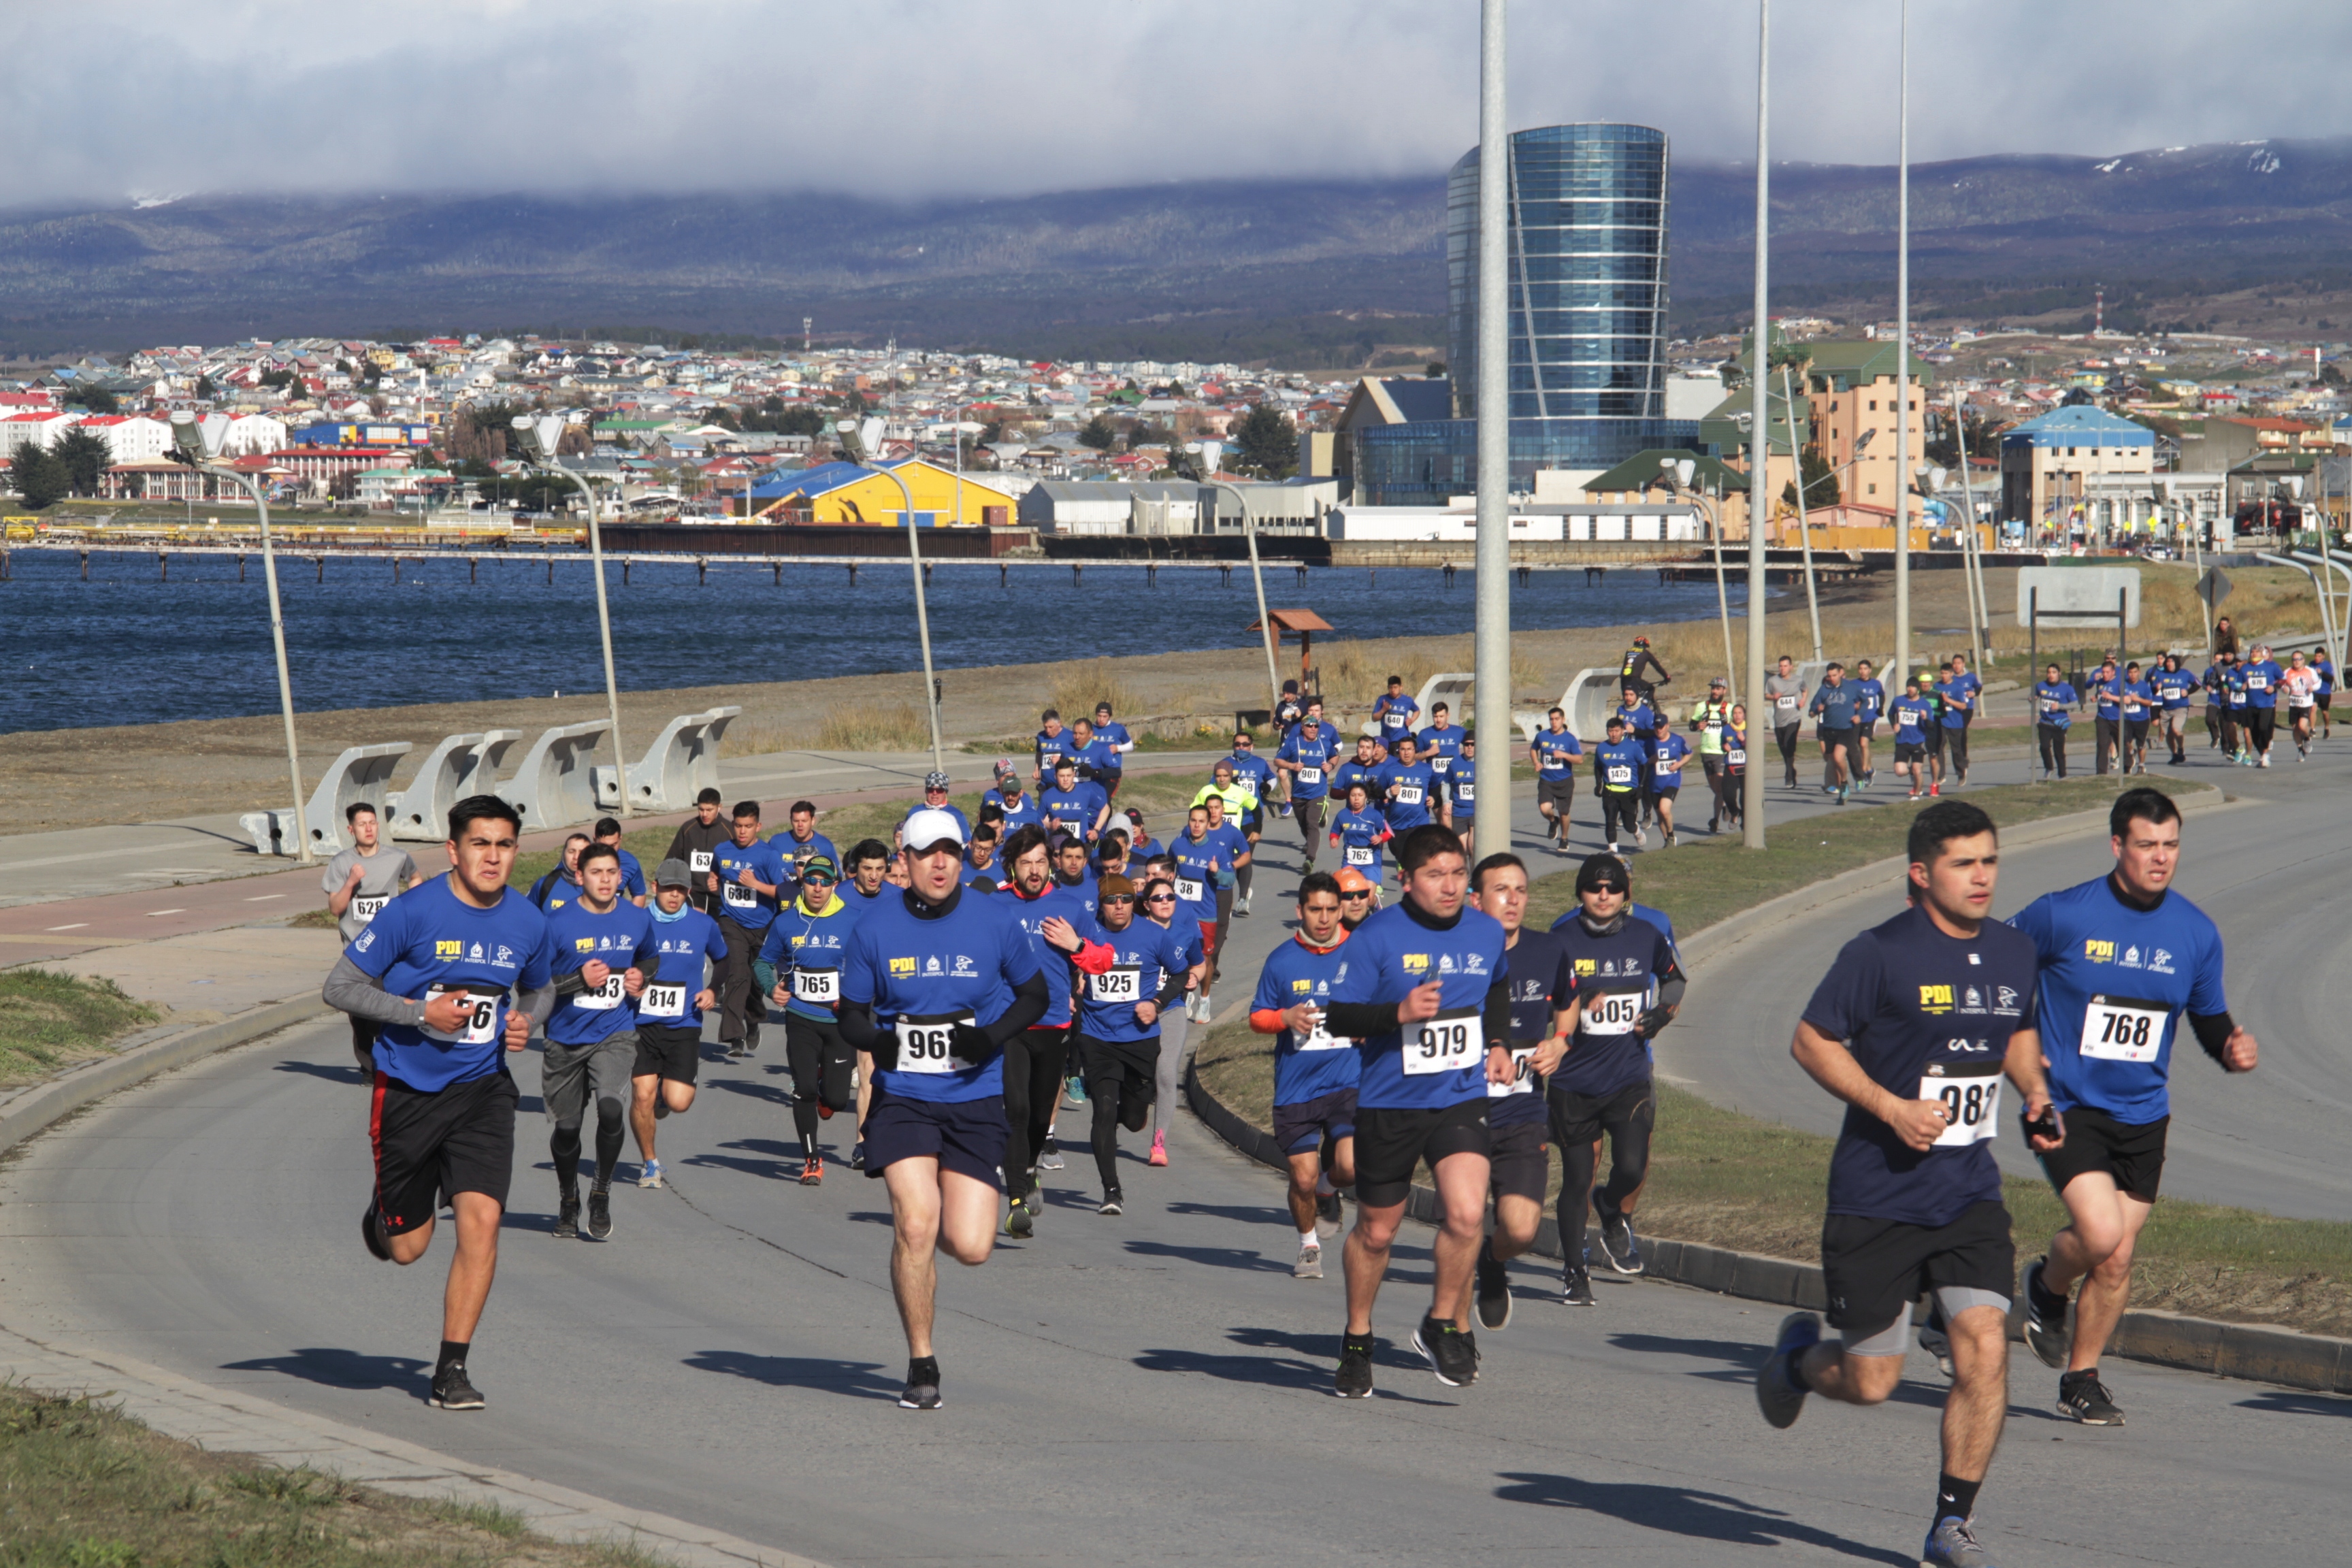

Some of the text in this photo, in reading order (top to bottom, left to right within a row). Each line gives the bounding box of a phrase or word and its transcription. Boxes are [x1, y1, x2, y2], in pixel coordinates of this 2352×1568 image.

[1302, 770, 1316, 779] 901
[1611, 770, 1628, 778] 1475
[1401, 789, 1417, 799] 801
[1352, 851, 1367, 860] 762
[728, 887, 751, 900] 638
[1180, 883, 1193, 895] 38
[358, 901, 382, 915] 628
[436, 941, 461, 955] PDI
[576, 938, 594, 949] PDI
[2085, 939, 2114, 956] PDI
[889, 957, 916, 972] PDI
[1403, 954, 1428, 968] PDI
[1575, 960, 1595, 971] PDI
[800, 975, 830, 994] 765
[1098, 975, 1131, 993] 925
[1292, 979, 1311, 991] PDI
[649, 988, 676, 1008] 814
[1919, 985, 1953, 1004] PDI
[2101, 1012, 2151, 1047] 768
[1419, 1025, 1467, 1058] 979
